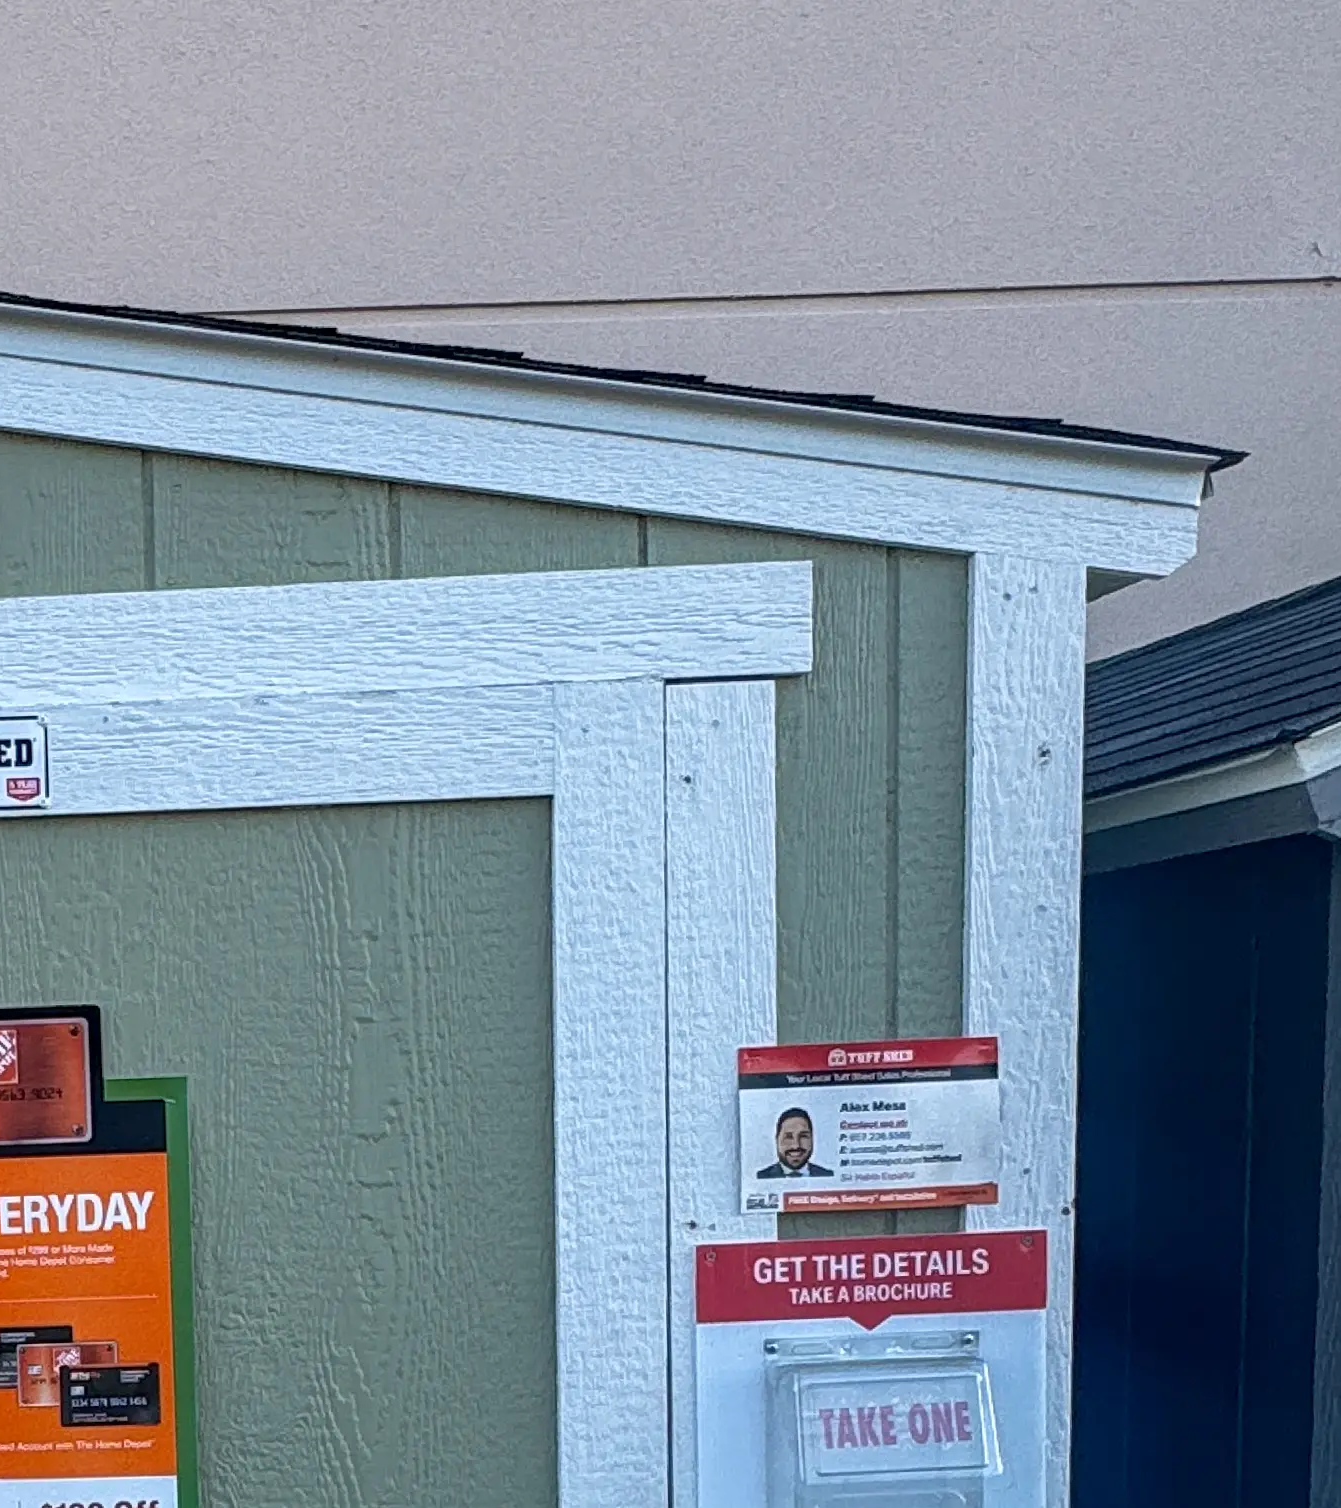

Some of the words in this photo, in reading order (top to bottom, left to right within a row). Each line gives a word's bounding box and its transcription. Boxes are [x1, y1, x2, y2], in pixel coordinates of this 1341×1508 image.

[848, 1052, 881, 1064] TUFF
[840, 1103, 870, 1112] Alex
[753, 1257, 805, 1284] GET
[812, 1254, 866, 1282] THE
[873, 1249, 990, 1278] DETAILS
[790, 1287, 835, 1306] TAKE
[837, 1286, 850, 1303] A
[853, 1282, 953, 1303] BROCHURE
[819, 1404, 898, 1450] TAKE
[909, 1401, 973, 1445] ONE
